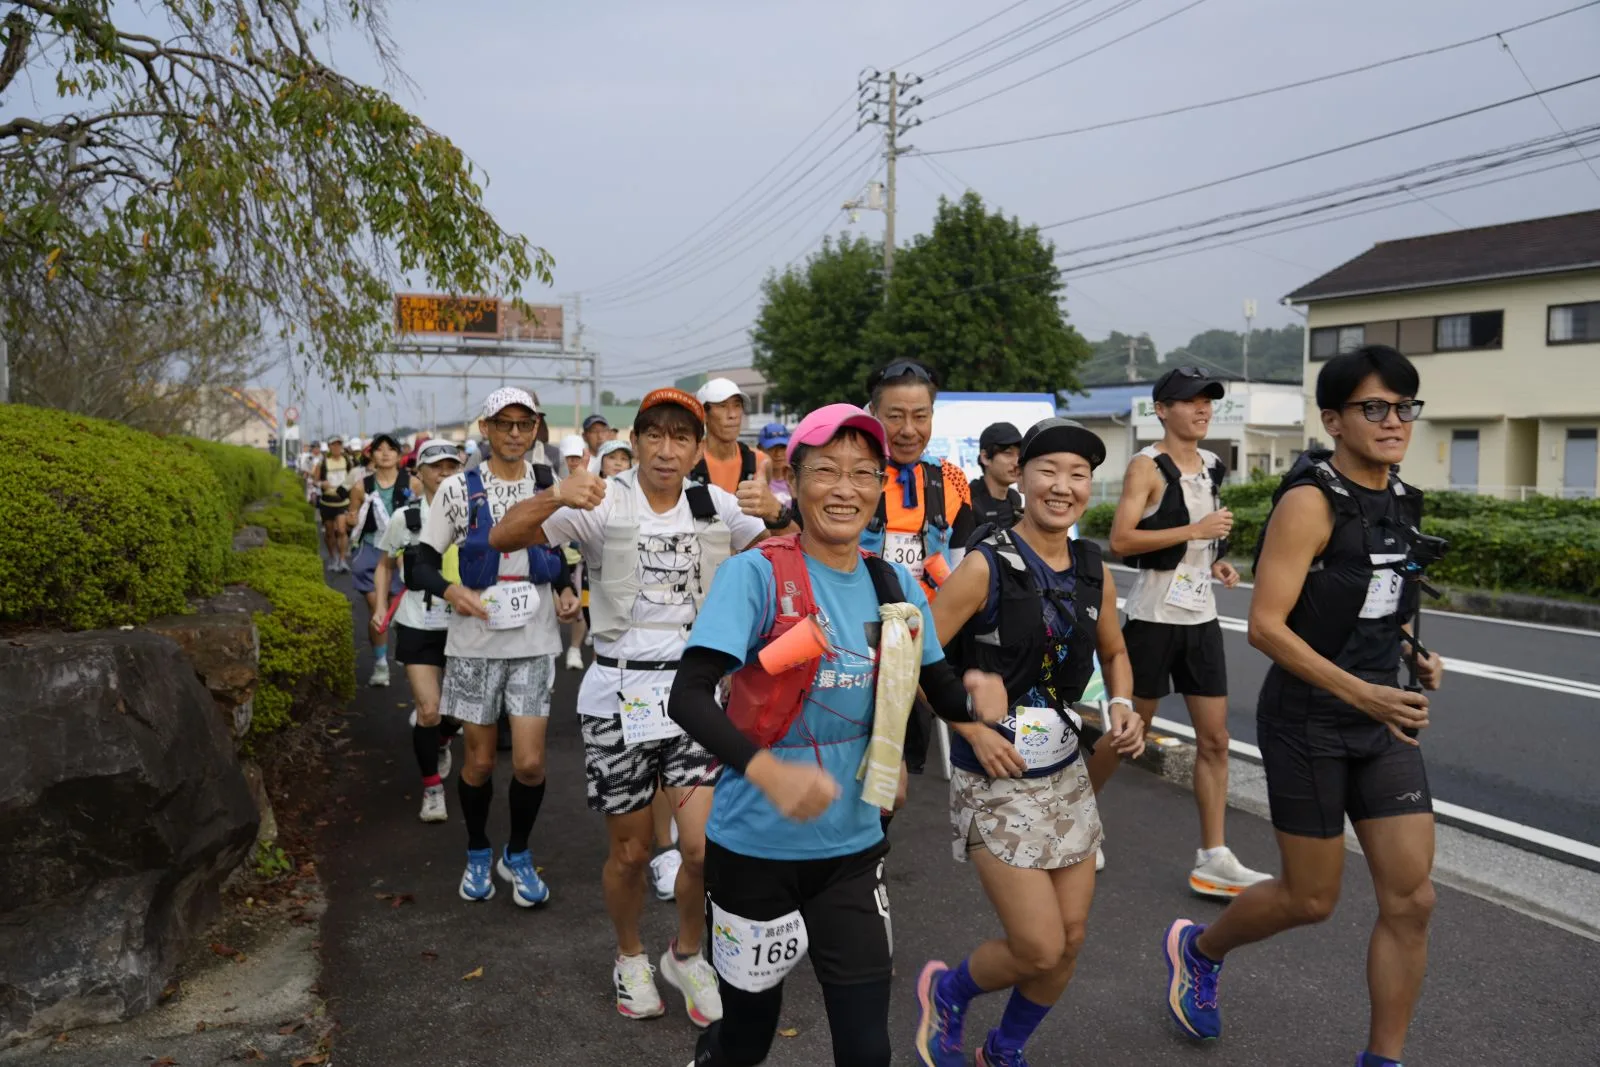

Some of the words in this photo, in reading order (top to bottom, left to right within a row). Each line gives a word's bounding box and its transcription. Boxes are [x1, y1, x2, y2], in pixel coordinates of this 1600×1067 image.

[894, 547, 923, 564] 304
[510, 594, 529, 612] 97
[751, 937, 799, 967] 168
